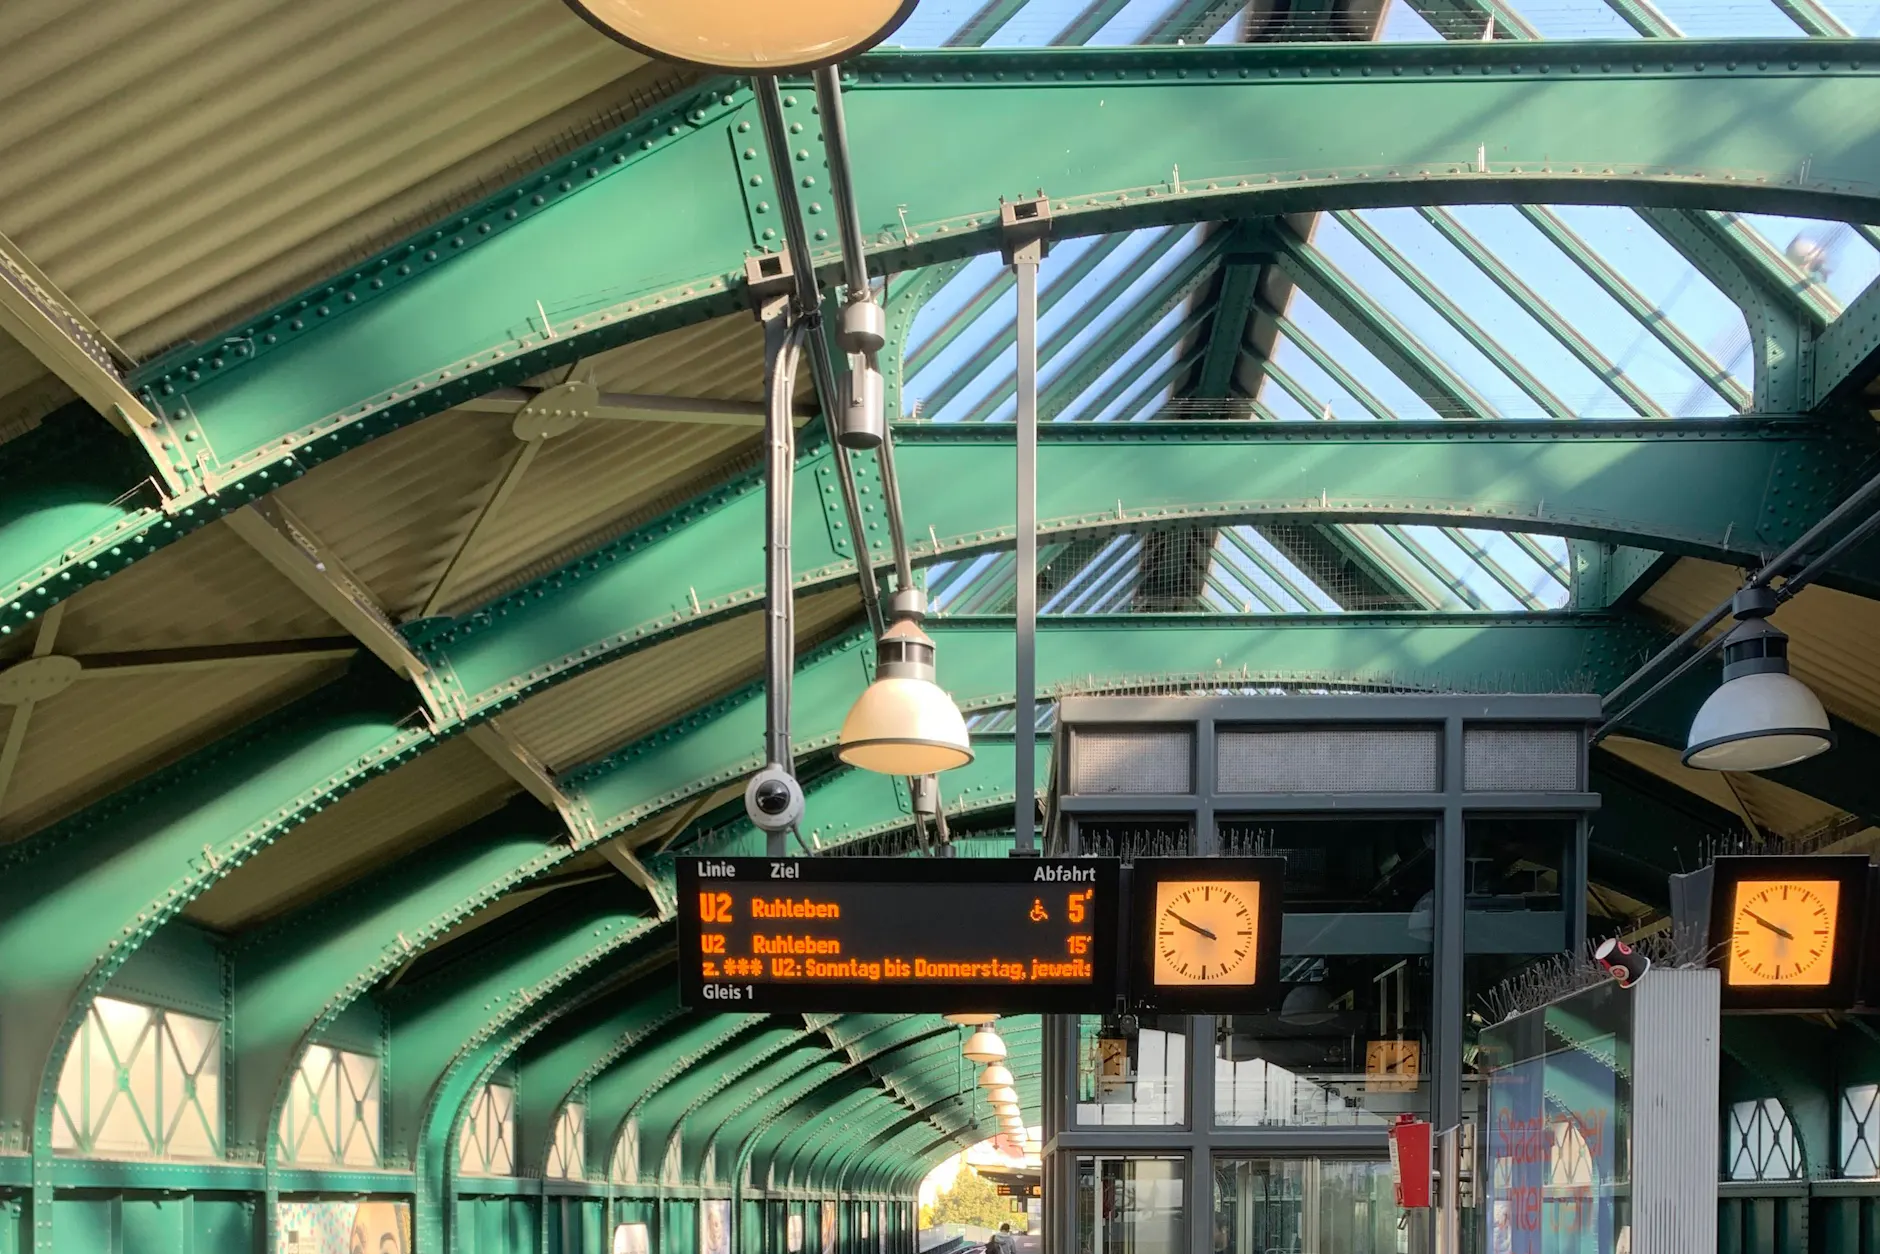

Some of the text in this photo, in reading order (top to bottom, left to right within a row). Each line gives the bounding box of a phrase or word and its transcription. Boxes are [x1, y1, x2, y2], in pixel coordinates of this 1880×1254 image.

[697, 861, 1096, 882] Linie Ziel Abfahrt
[699, 892, 733, 923] U2
[751, 898, 840, 918] Ruhleben
[701, 934, 726, 954] U2
[752, 934, 840, 954] Ruhleben
[771, 958, 802, 977] U2:
[805, 958, 881, 980] Sonntag
[884, 958, 911, 977] bis
[914, 958, 1027, 981] Donnerstag,
[702, 984, 753, 1000] Gleis 1
[1496, 1107, 1606, 1164] Staatser
